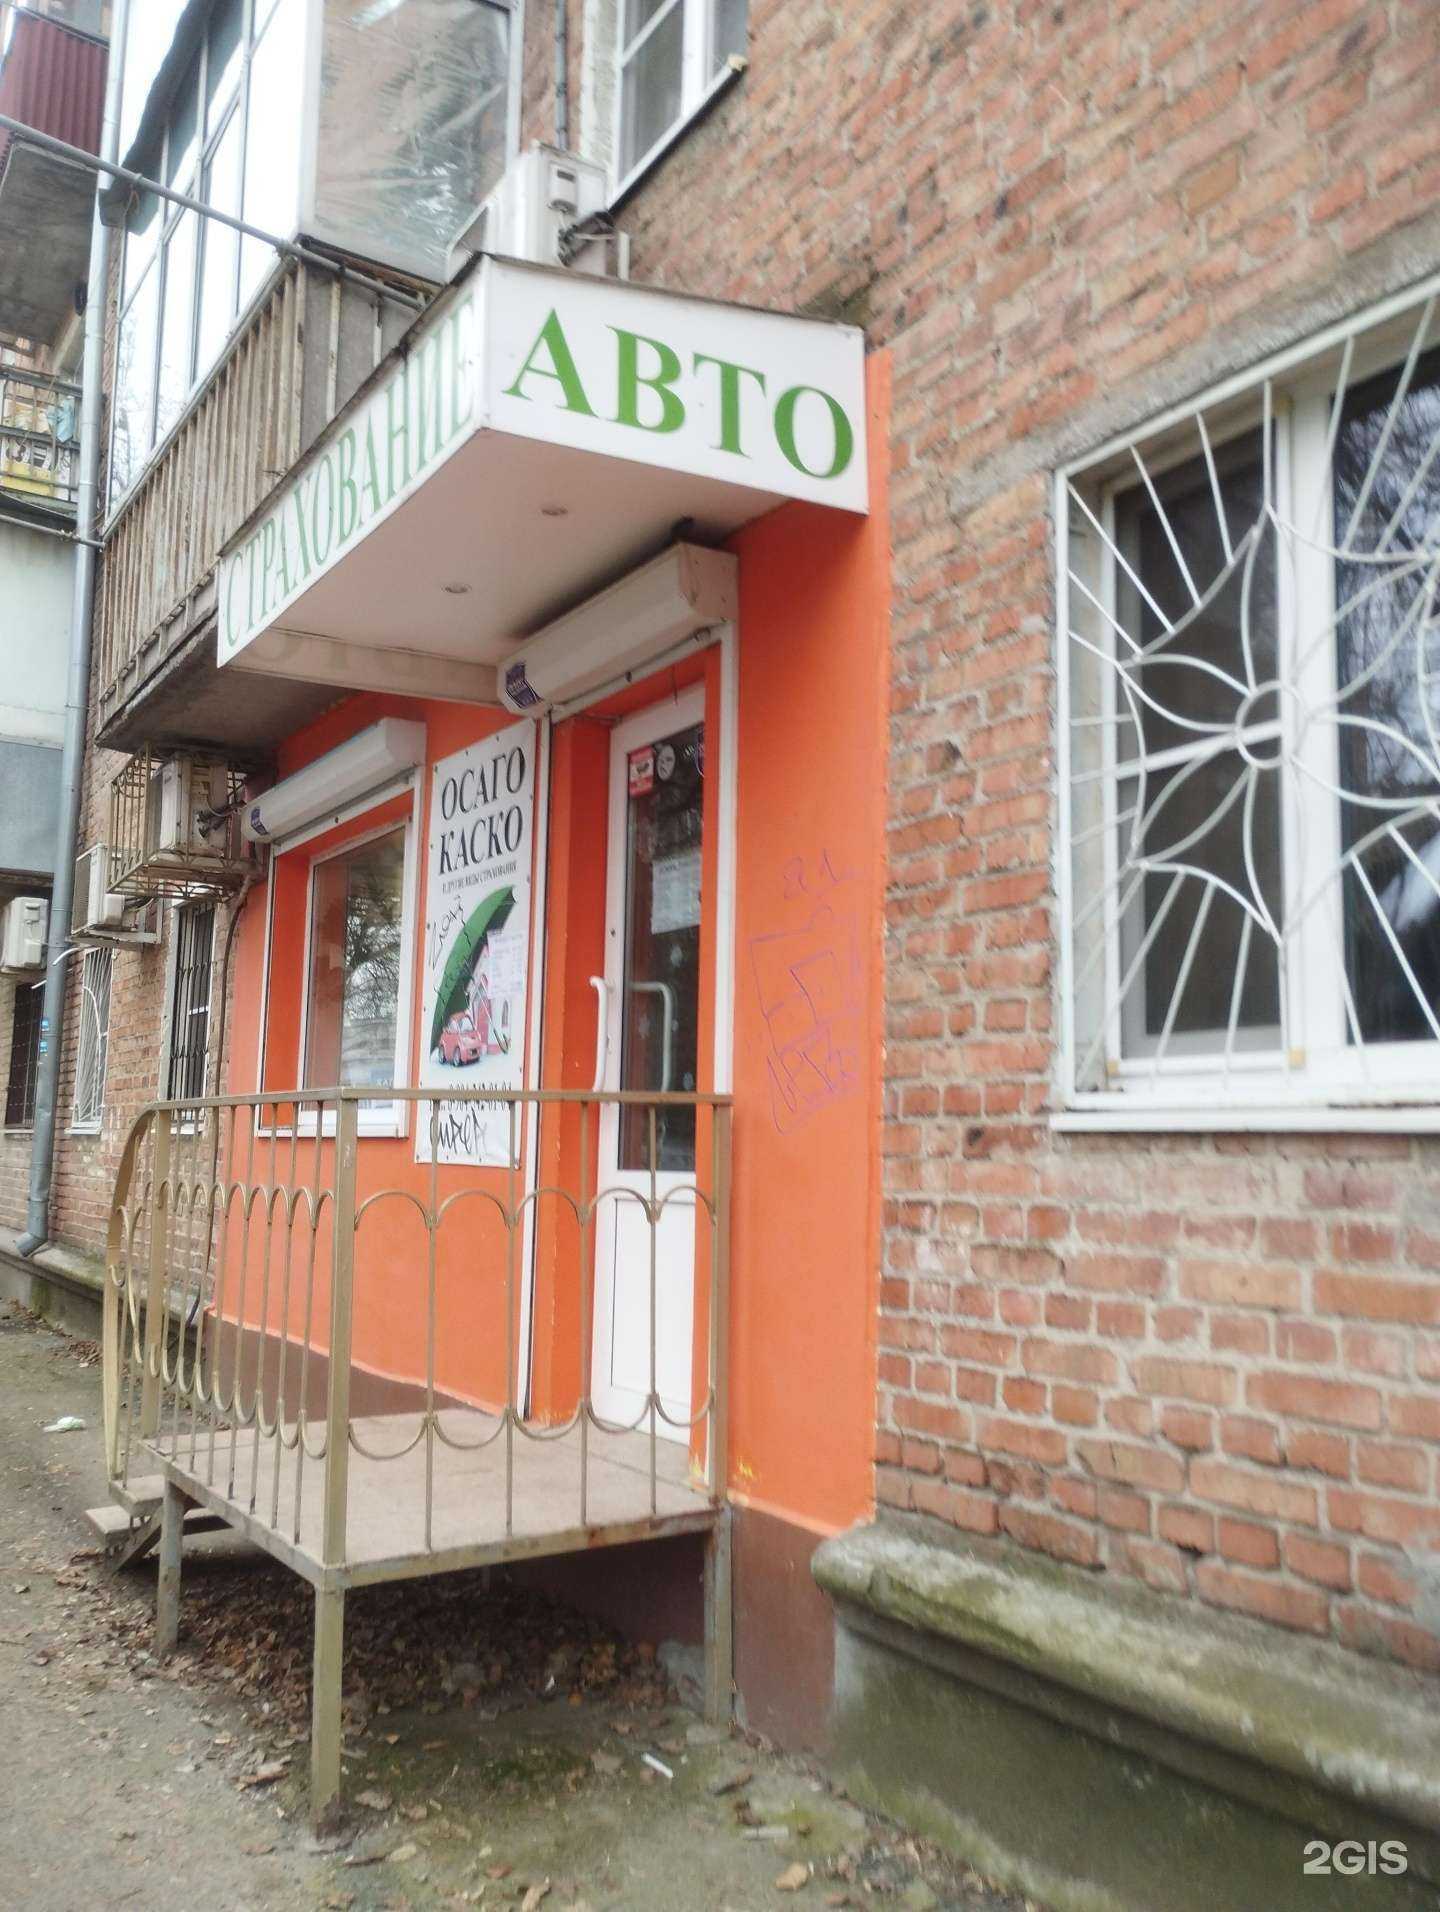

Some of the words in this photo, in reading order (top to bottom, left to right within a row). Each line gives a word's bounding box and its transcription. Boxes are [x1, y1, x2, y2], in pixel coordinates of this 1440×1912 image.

[502, 306, 855, 480] АВТО
[226, 293, 476, 647] СТРАХОВАНИЕ
[439, 805, 523, 876] КАСКО
[441, 746, 526, 821] ОСАГО
